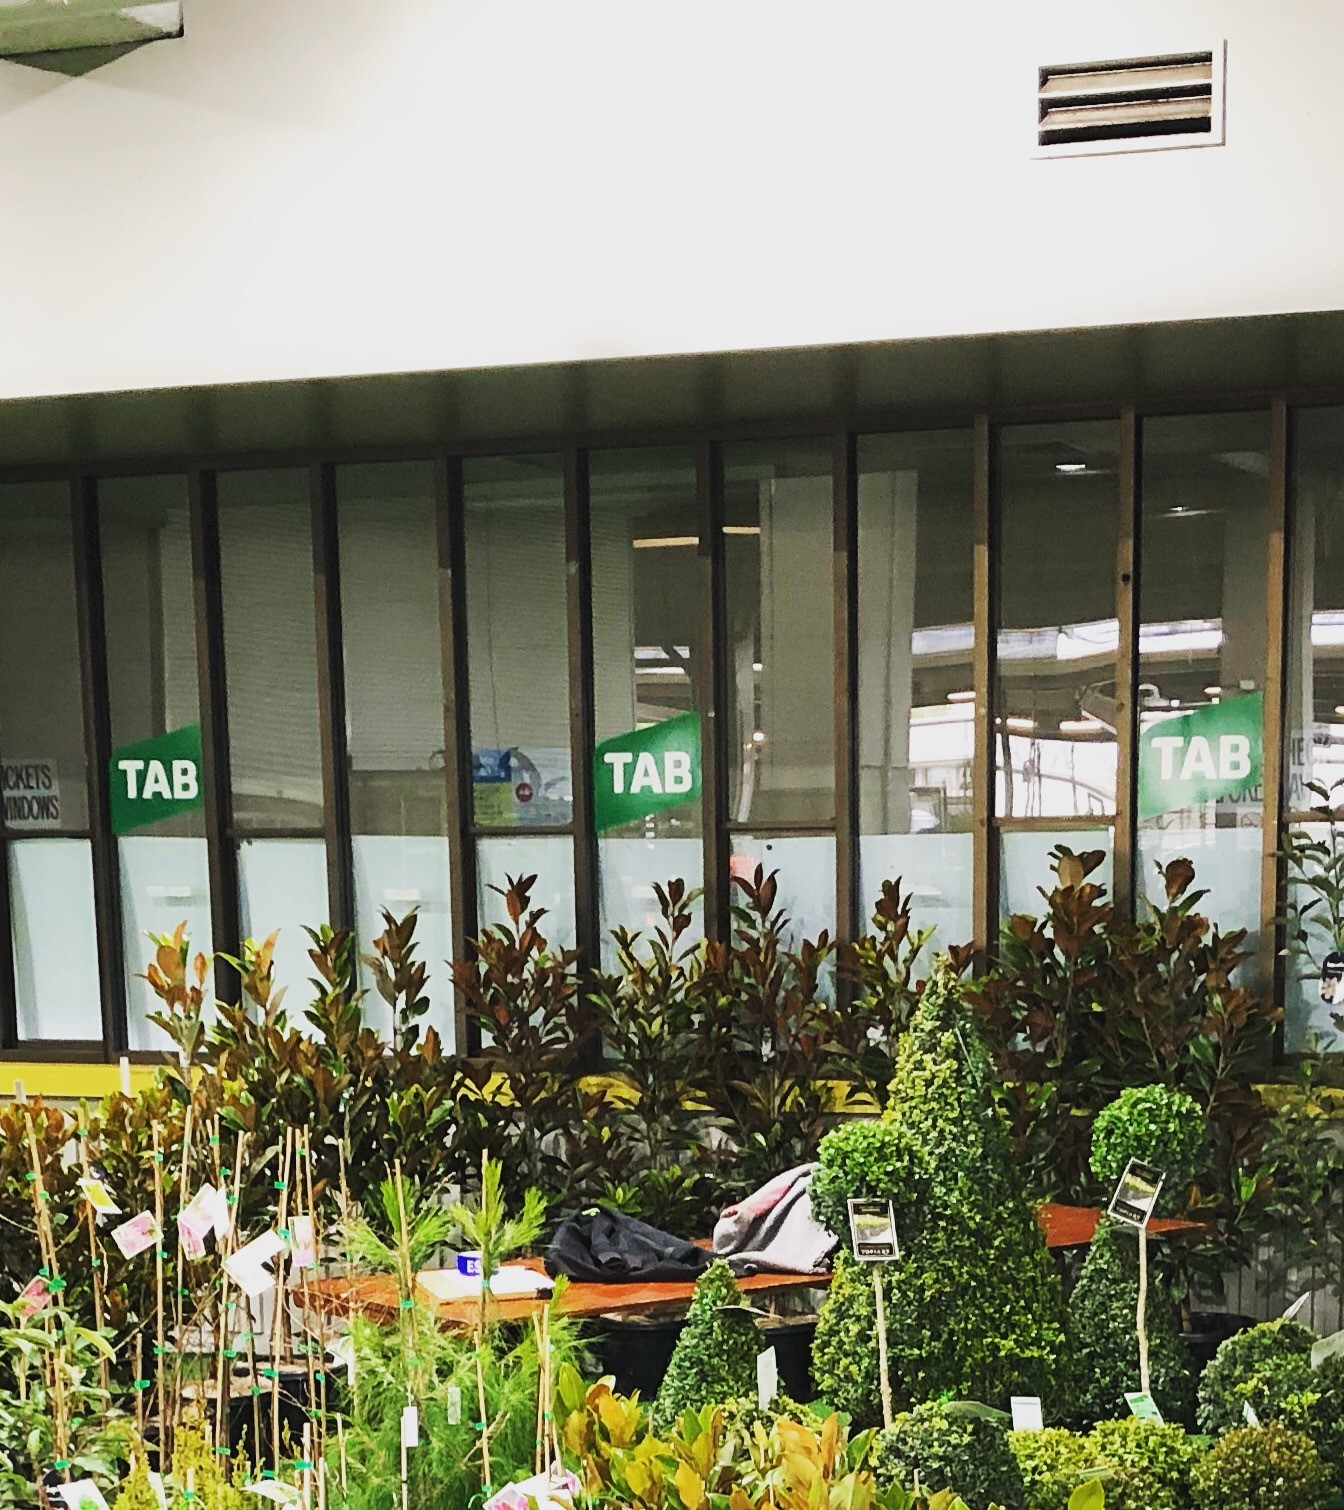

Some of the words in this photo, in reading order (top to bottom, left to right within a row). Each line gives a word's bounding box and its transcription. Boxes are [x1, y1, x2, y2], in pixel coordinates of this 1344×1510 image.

[0, 764, 52, 790] ICKETS
[603, 751, 693, 794] TAB
[1151, 734, 1252, 781] TAB
[118, 759, 199, 800] TAB
